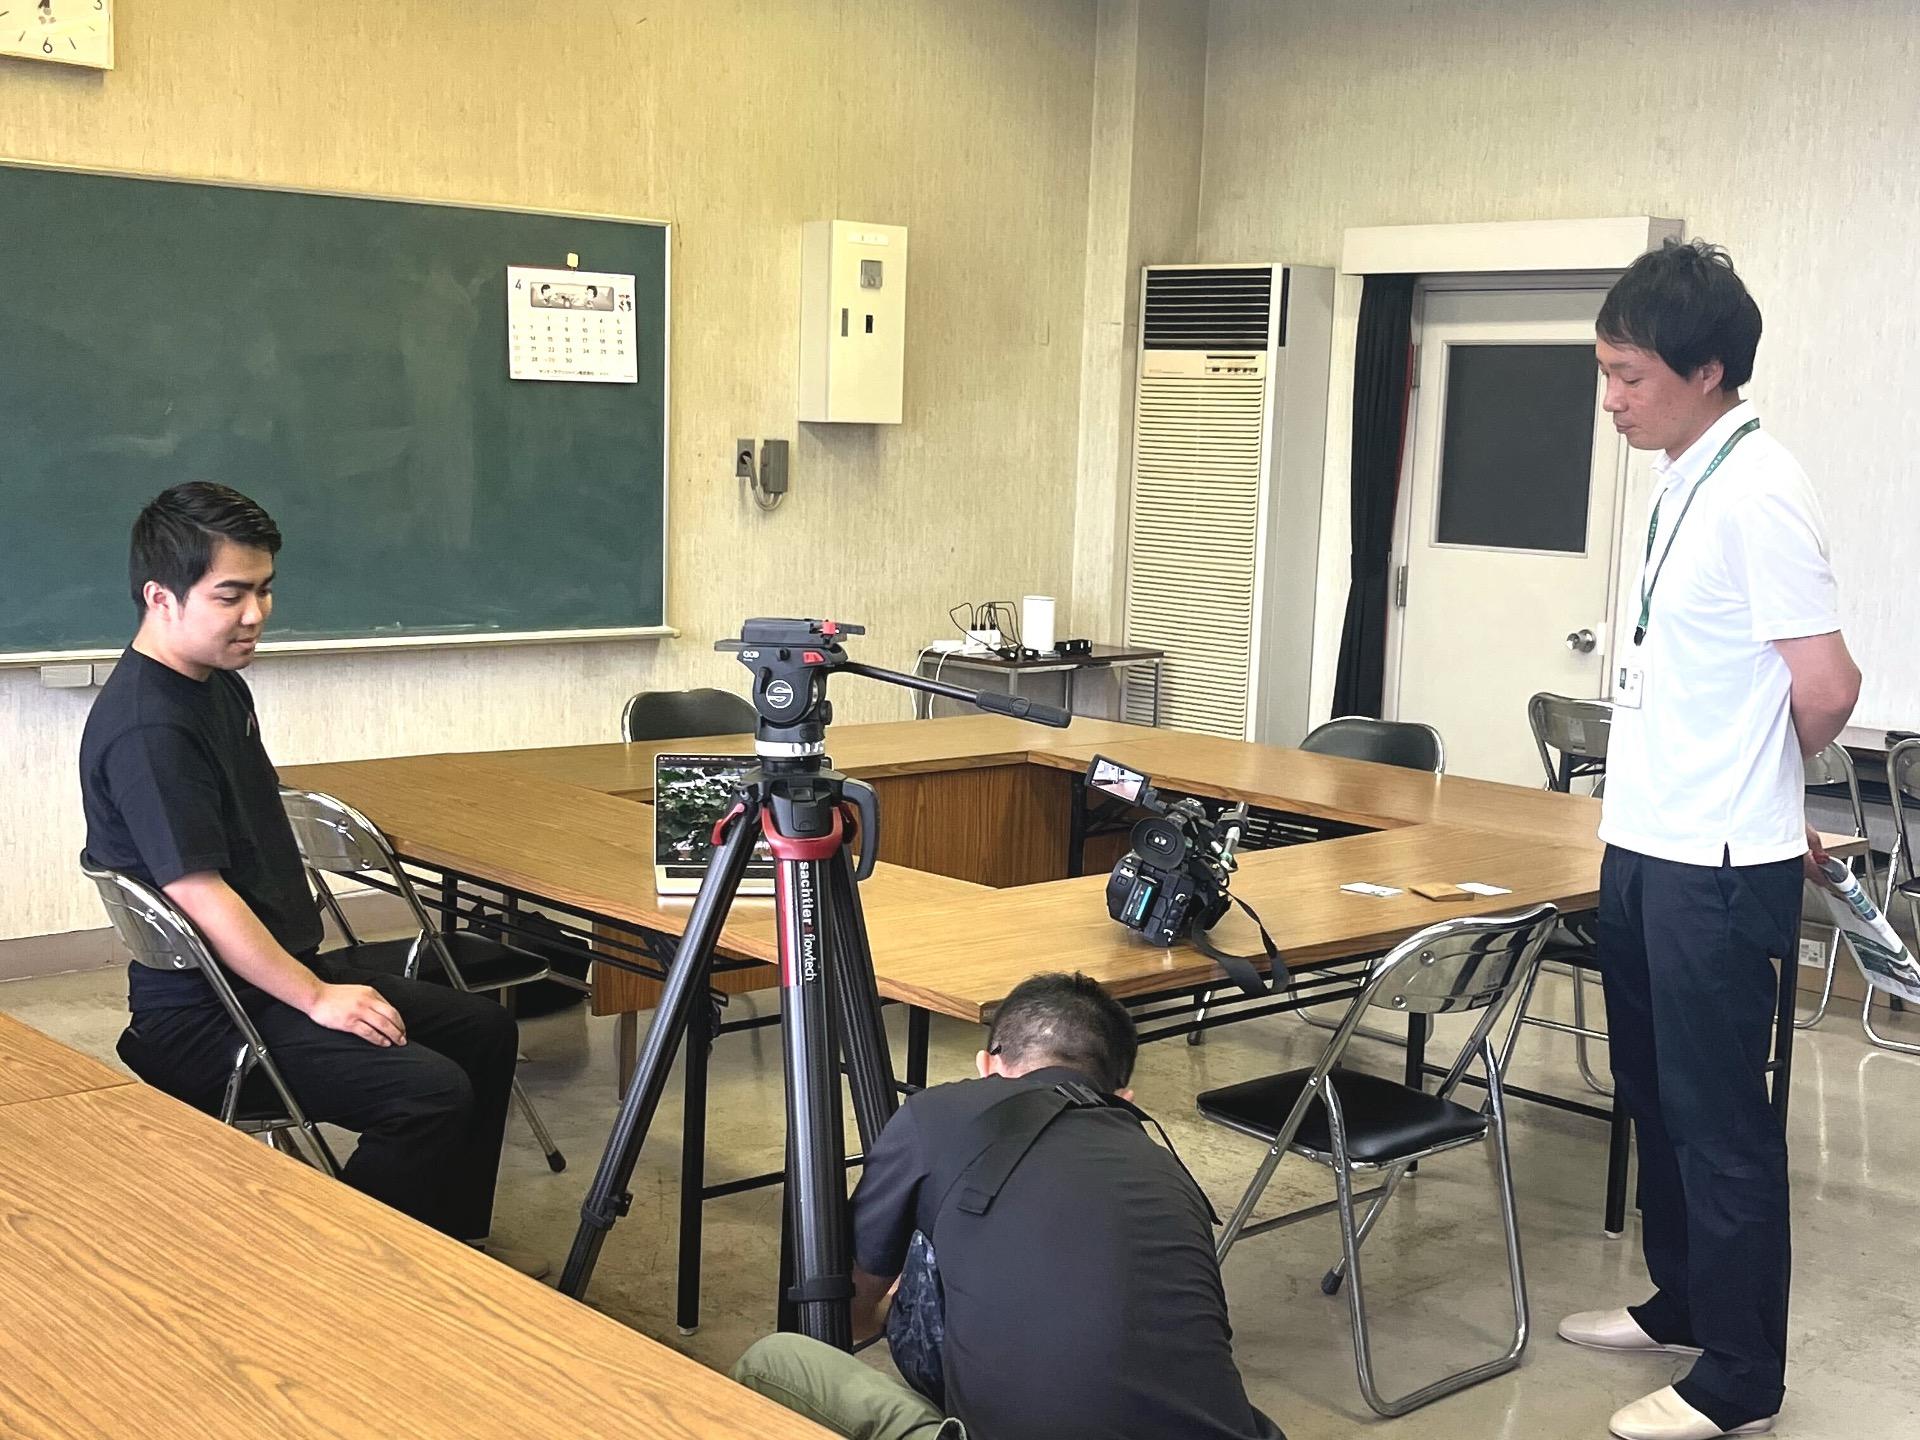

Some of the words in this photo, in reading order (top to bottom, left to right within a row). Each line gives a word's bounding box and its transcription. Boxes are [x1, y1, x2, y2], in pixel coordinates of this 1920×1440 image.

[93, 0, 103, 10] 3
[42, 37, 53, 54] 6
[515, 278, 522, 290] 4
[799, 861, 815, 926] sachtler
[803, 933, 818, 982] flowtech
